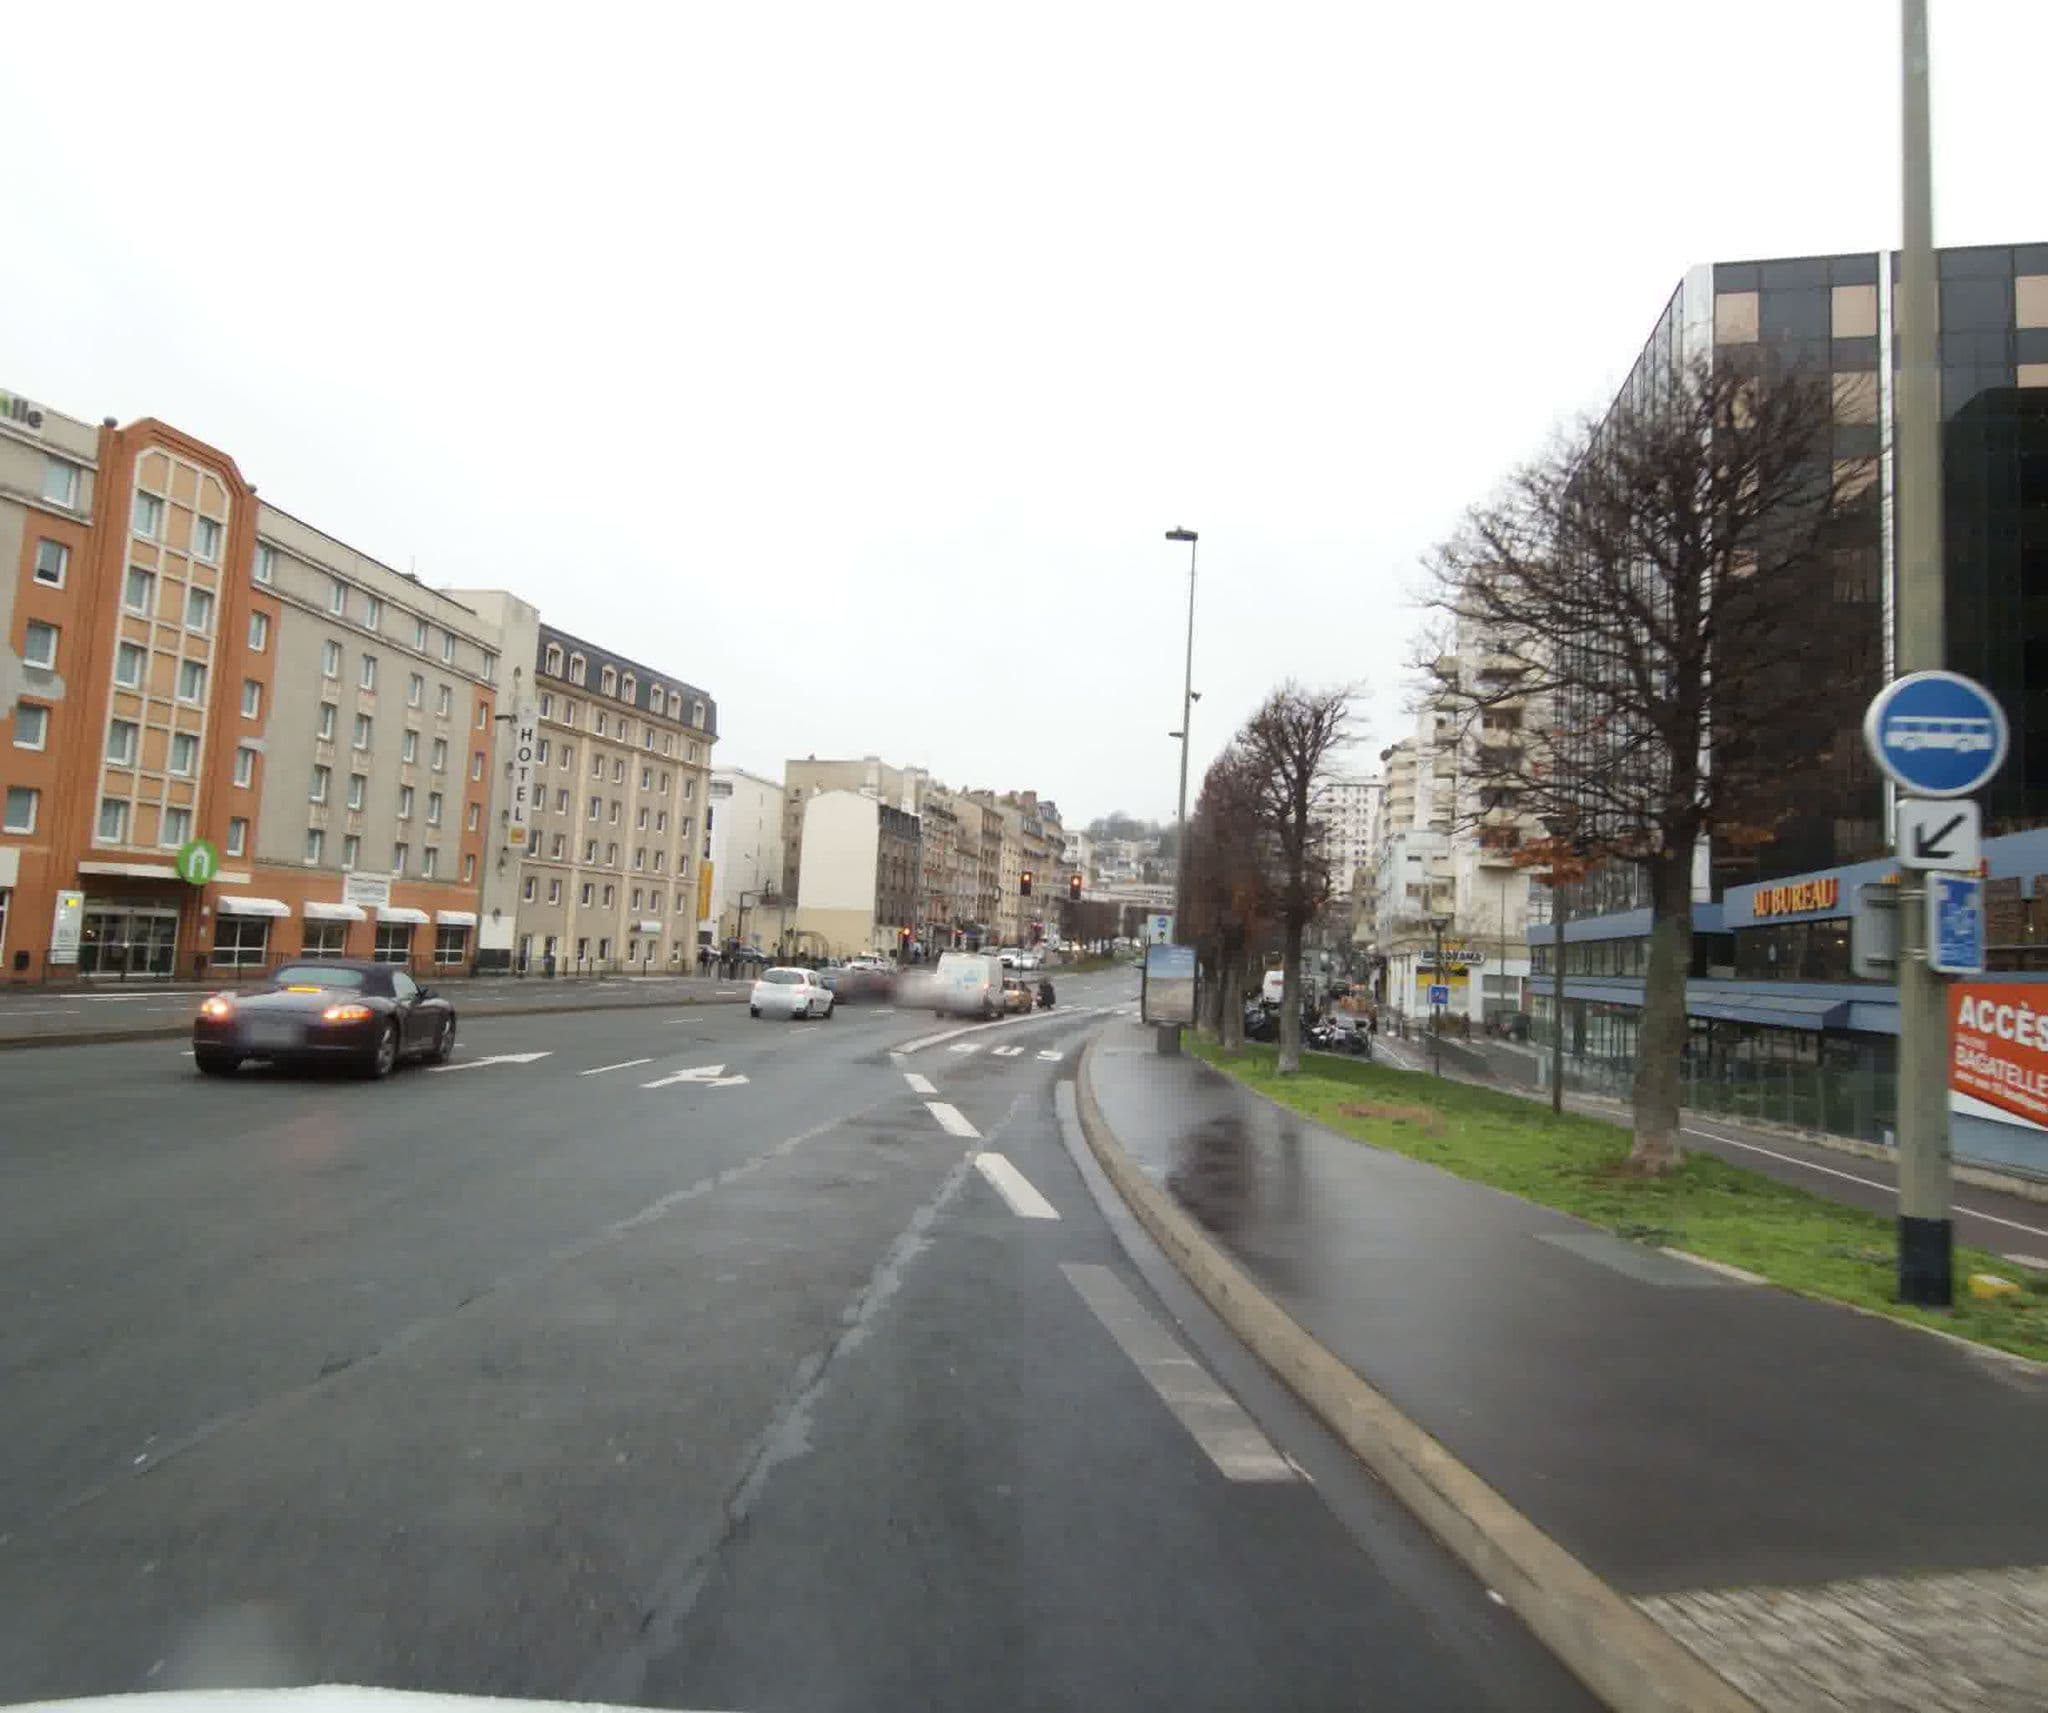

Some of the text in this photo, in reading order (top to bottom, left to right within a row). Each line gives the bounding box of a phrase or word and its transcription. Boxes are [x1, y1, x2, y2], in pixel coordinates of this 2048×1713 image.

[514, 728, 533, 822] HOTEL
[1754, 878, 1838, 917] AU BUREAU
[1958, 994, 2048, 1052] ACCÈS
